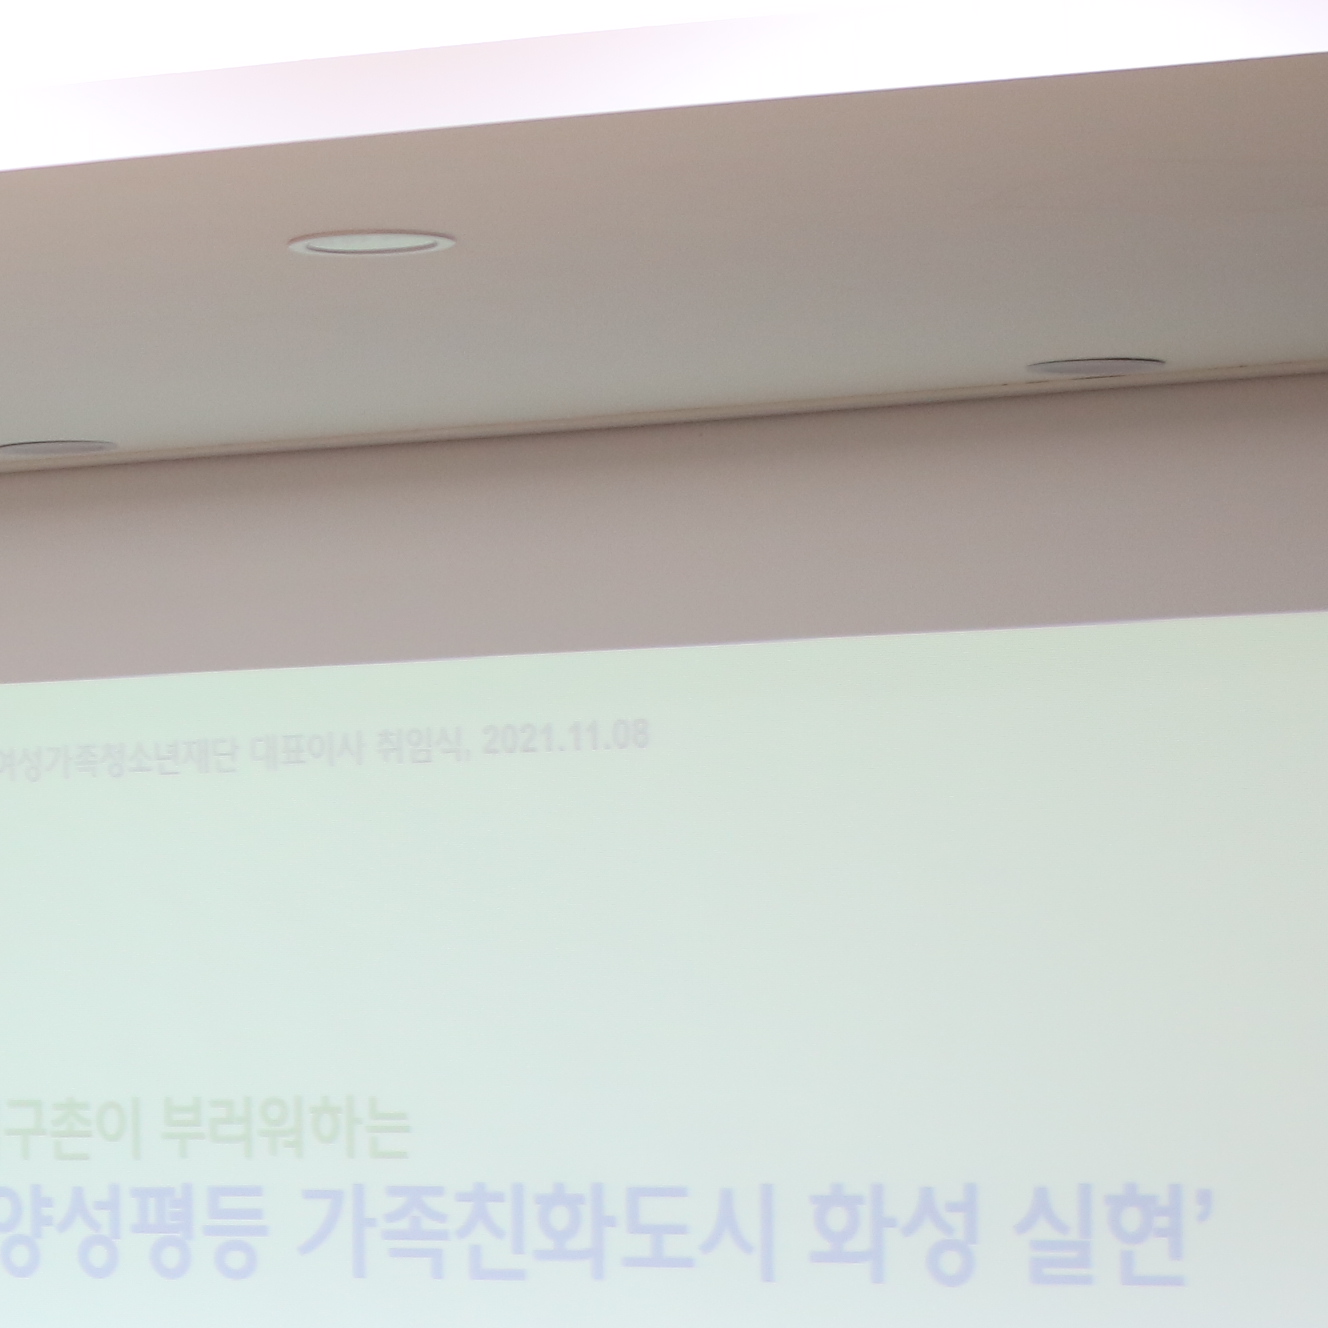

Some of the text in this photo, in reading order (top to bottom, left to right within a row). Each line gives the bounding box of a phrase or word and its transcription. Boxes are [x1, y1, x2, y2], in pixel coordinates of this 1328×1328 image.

[248, 728, 367, 773] 대표이사
[482, 717, 653, 756] 2021.11.08
[160, 1093, 414, 1160] 부러워하는
[297, 1181, 777, 1284] 가족친화도시
[808, 1181, 982, 1288] 화성
